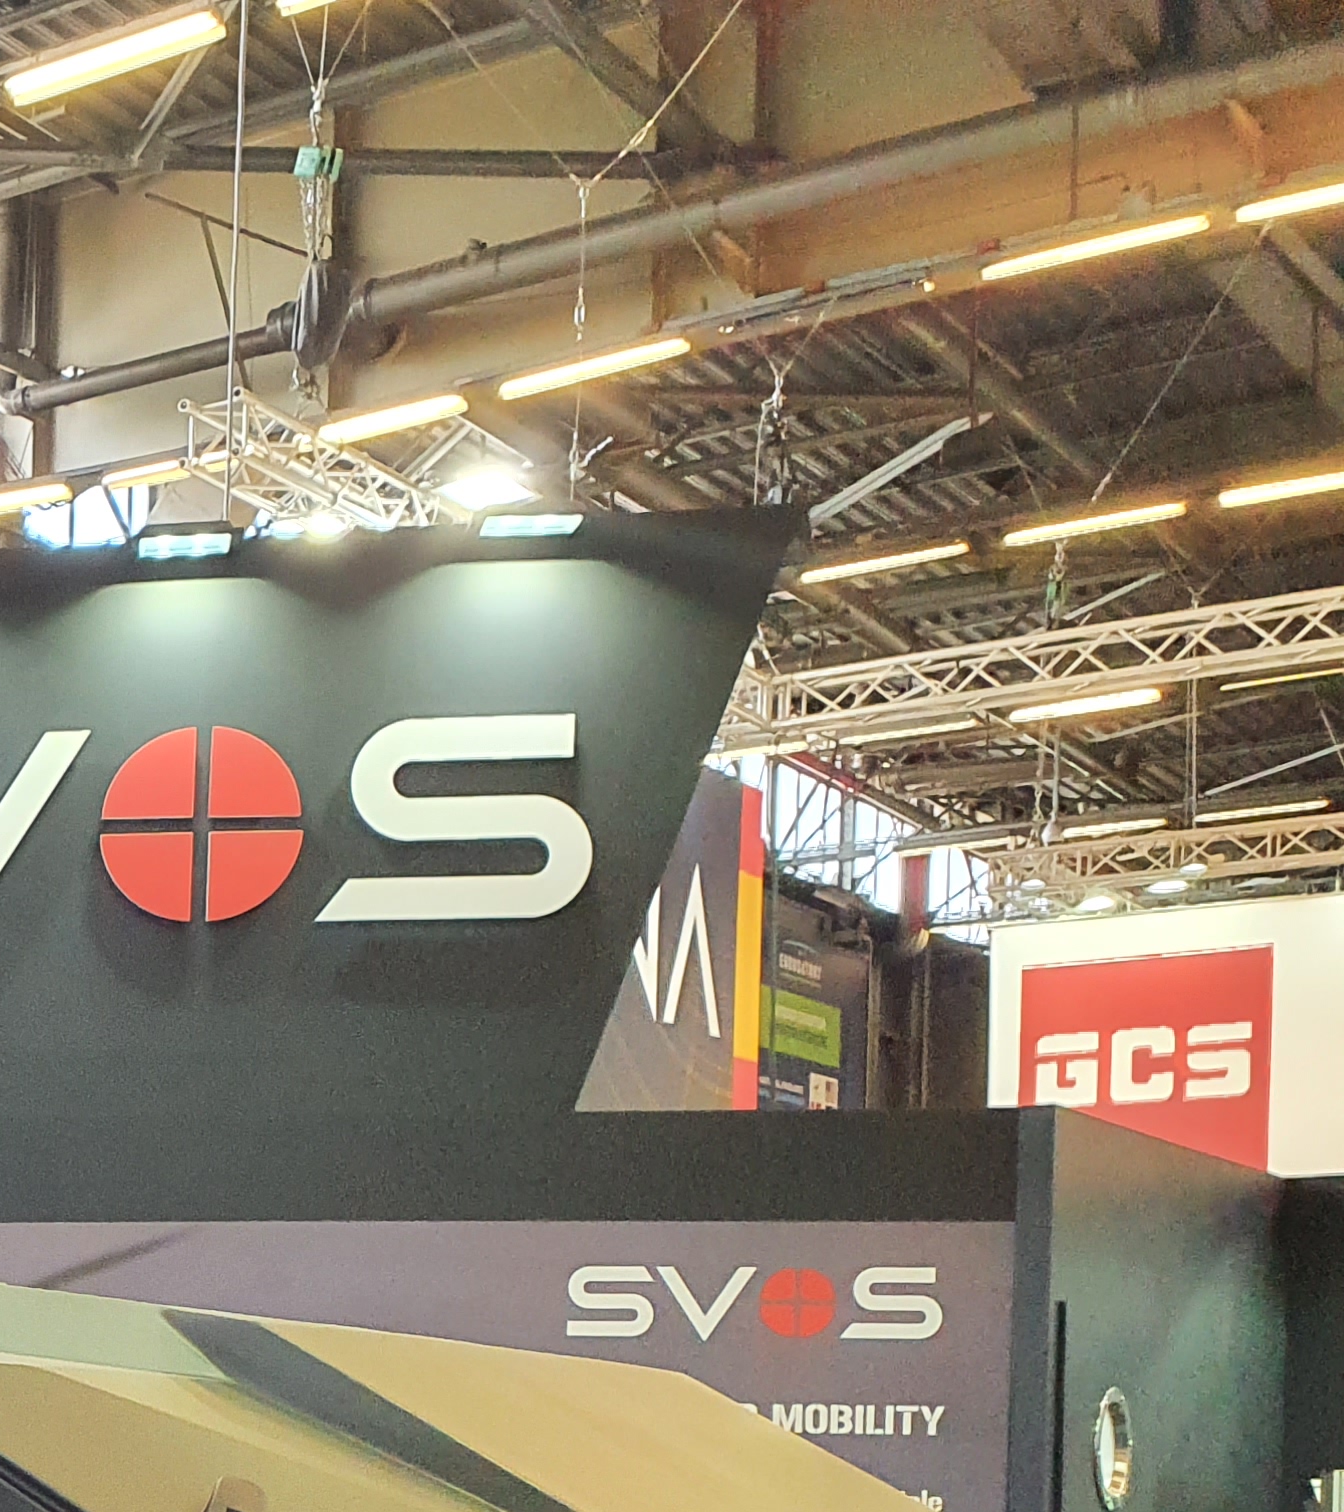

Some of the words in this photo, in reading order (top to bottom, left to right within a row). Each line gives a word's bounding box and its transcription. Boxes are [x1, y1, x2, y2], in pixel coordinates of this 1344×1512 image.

[1034, 1020, 1254, 1108] GCS
[566, 1265, 944, 1342] SVOS
[771, 1402, 946, 1436] MOBILITY
